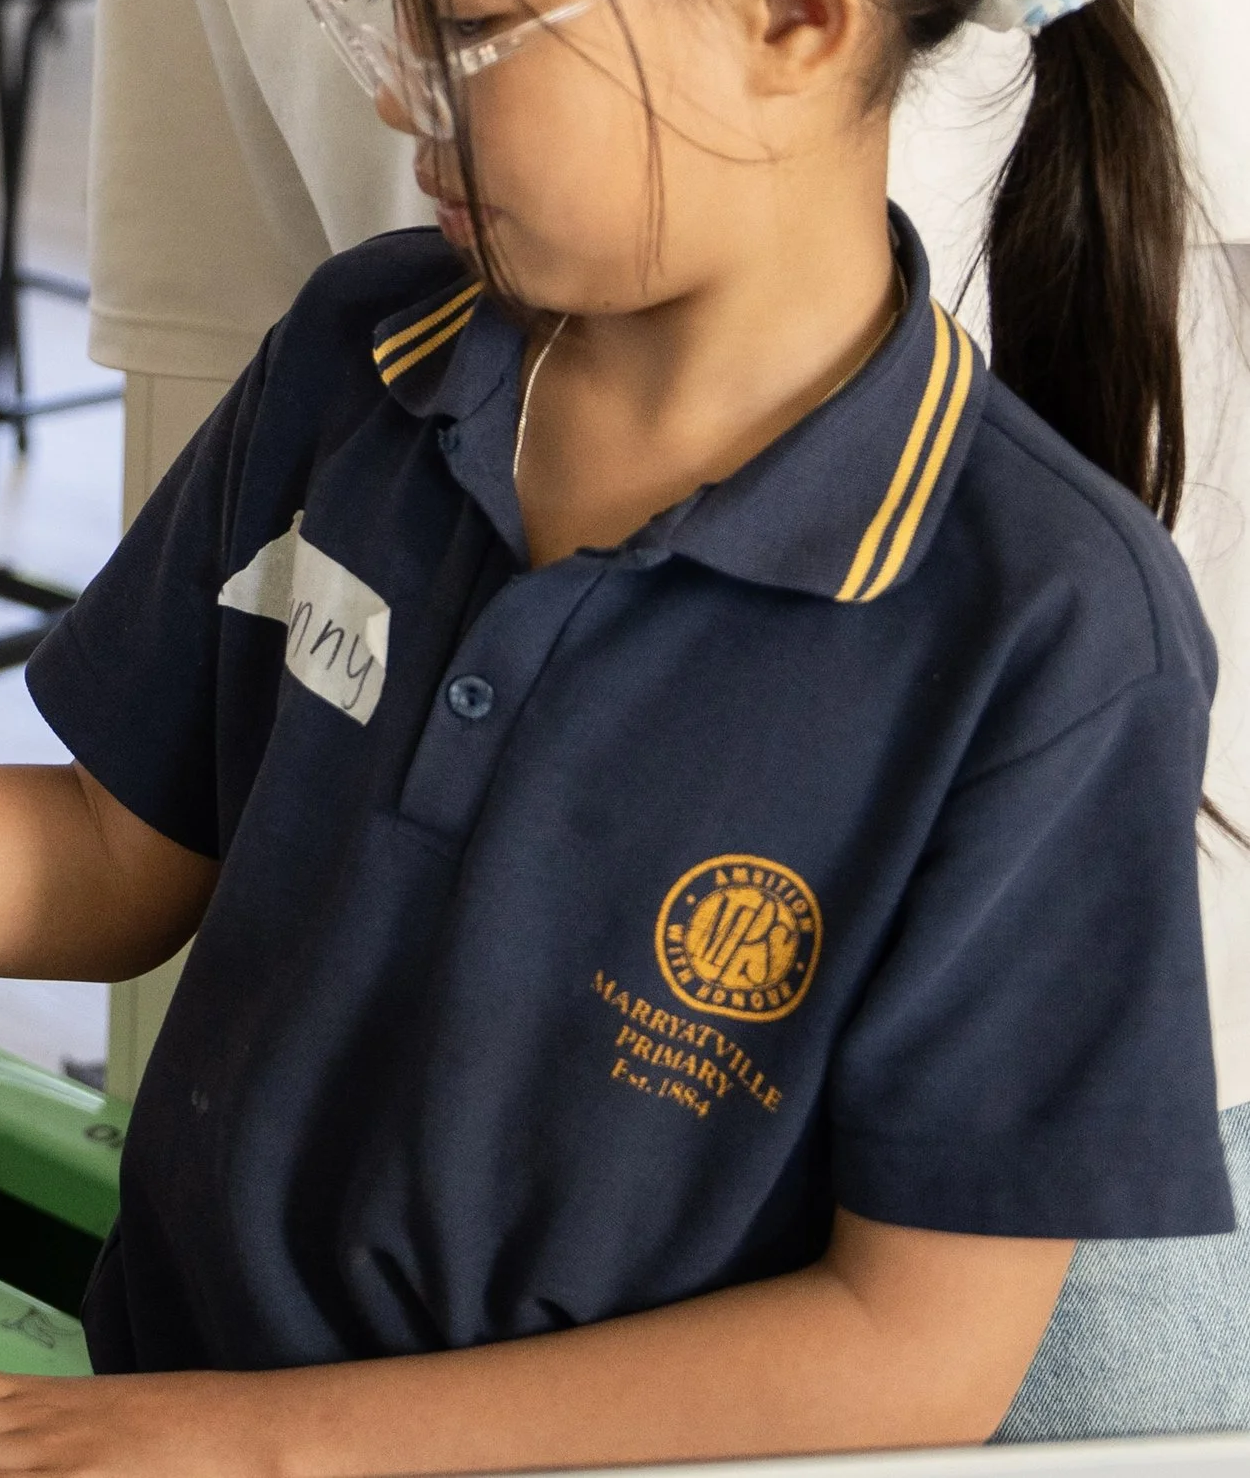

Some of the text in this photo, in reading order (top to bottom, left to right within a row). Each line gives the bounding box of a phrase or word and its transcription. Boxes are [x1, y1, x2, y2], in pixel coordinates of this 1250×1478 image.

[288, 598, 374, 710] nny
[591, 969, 783, 1113] MARRYATVILLE
[615, 1025, 735, 1098] PRIMARY
[610, 1057, 711, 1119] Est. 1884
